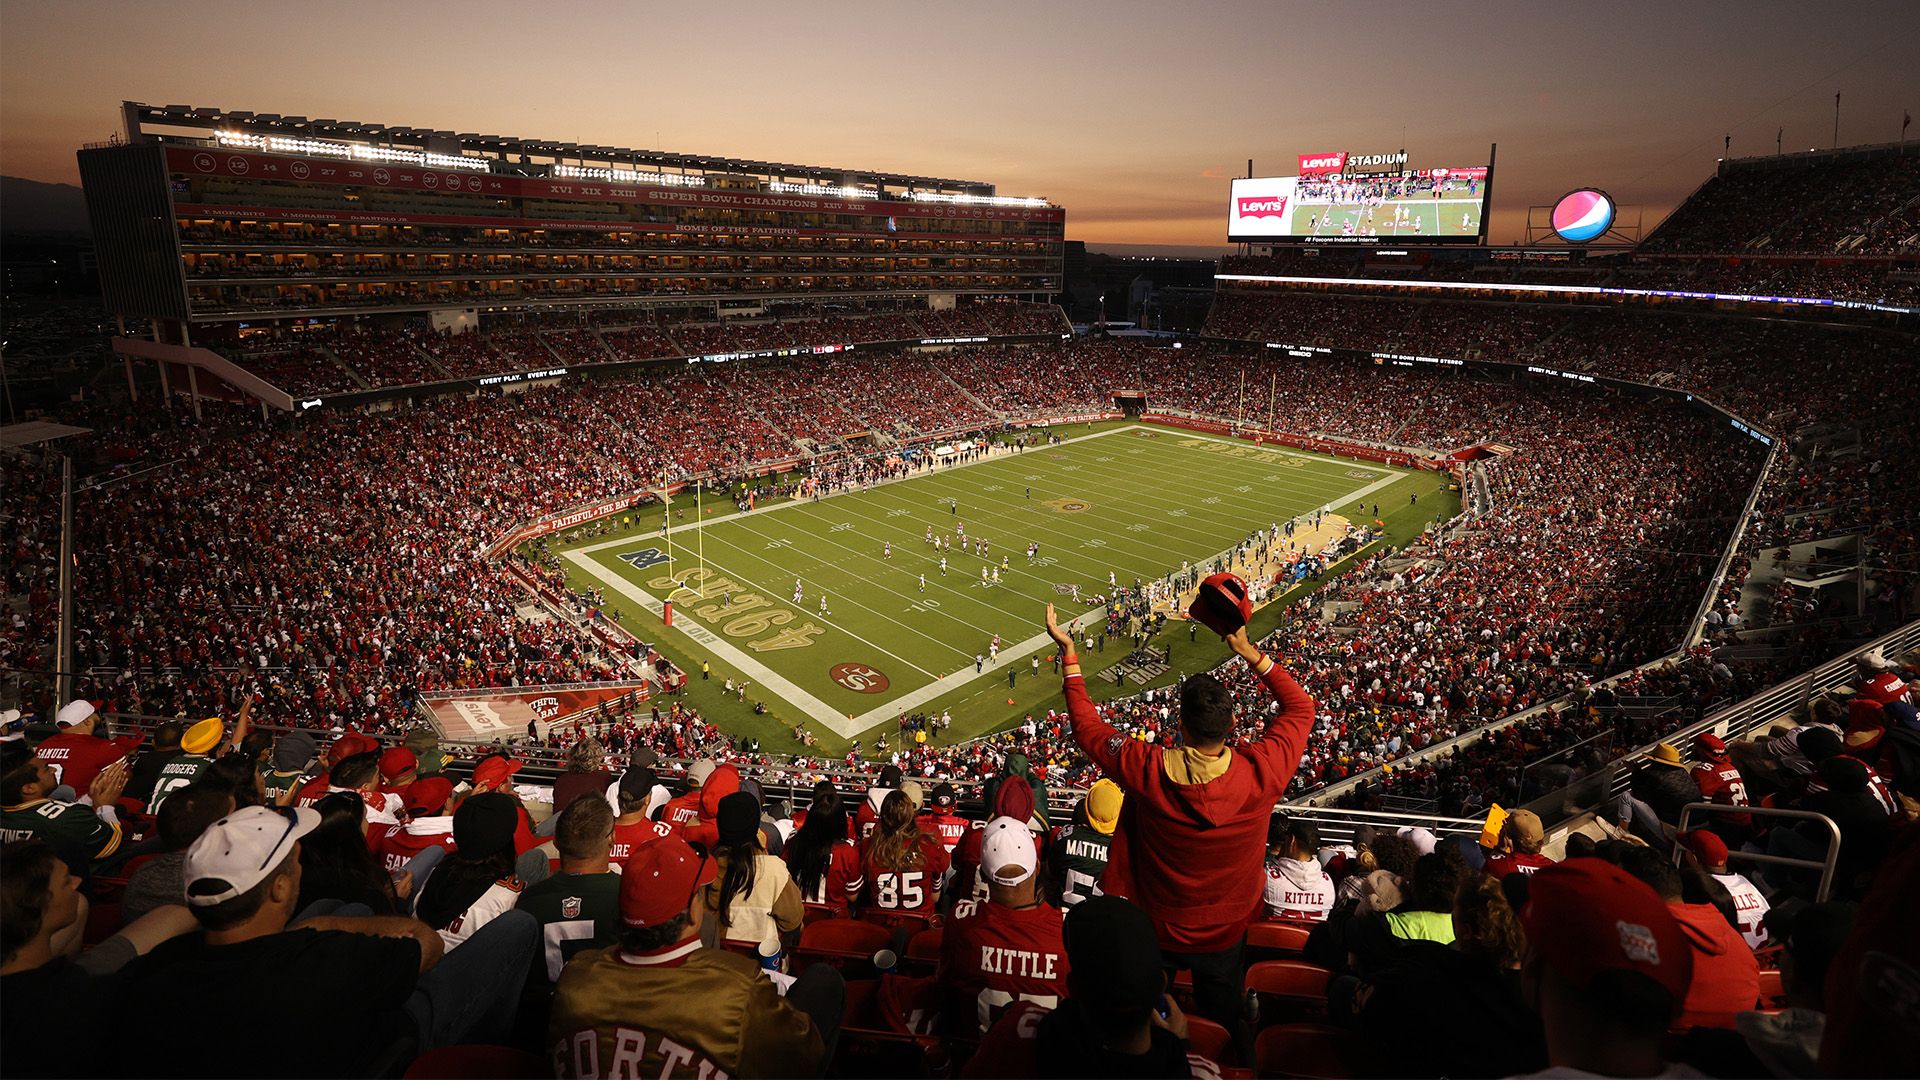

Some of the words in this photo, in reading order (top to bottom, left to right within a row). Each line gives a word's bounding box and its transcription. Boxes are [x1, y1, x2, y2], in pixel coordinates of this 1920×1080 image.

[1348, 153, 1408, 167] STADIUM
[320, 168, 336, 176] 27
[550, 185, 573, 194] XVI
[581, 187, 602, 196] XIX
[610, 189, 637, 198] XXIII
[649, 190, 698, 202] SUPER
[701, 194, 742, 205] BOWL
[743, 197, 818, 209] CHAMPIONS
[823, 202, 843, 210] XXIV
[847, 203, 866, 211] XXIX
[675, 224, 709, 232] HOME
[752, 227, 800, 235] FAITHFUL
[1440, 358, 1464, 366] STEREO
[480, 376, 502, 386] EVERY
[503, 374, 522, 383] PLAY.
[527, 370, 548, 380] EVERY
[548, 368, 568, 377] GAME.
[1528, 366, 1545, 374] EVERY
[1562, 371, 1579, 380] EVERY
[1175, 439, 1314, 467] 49ERS
[551, 510, 594, 530] FAITHFUL
[597, 504, 615, 516] THE
[615, 498, 631, 511] BAY
[645, 566, 827, 653] 49ERS
[540, 705, 560, 720] BAY
[37, 748, 70, 760] SAMUEL
[162, 762, 199, 776] RODGERS
[671, 807, 699, 823] LOTT
[877, 871, 925, 910] 85
[1284, 891, 1325, 906] KITTLE
[980, 945, 1058, 980] KITTLE
